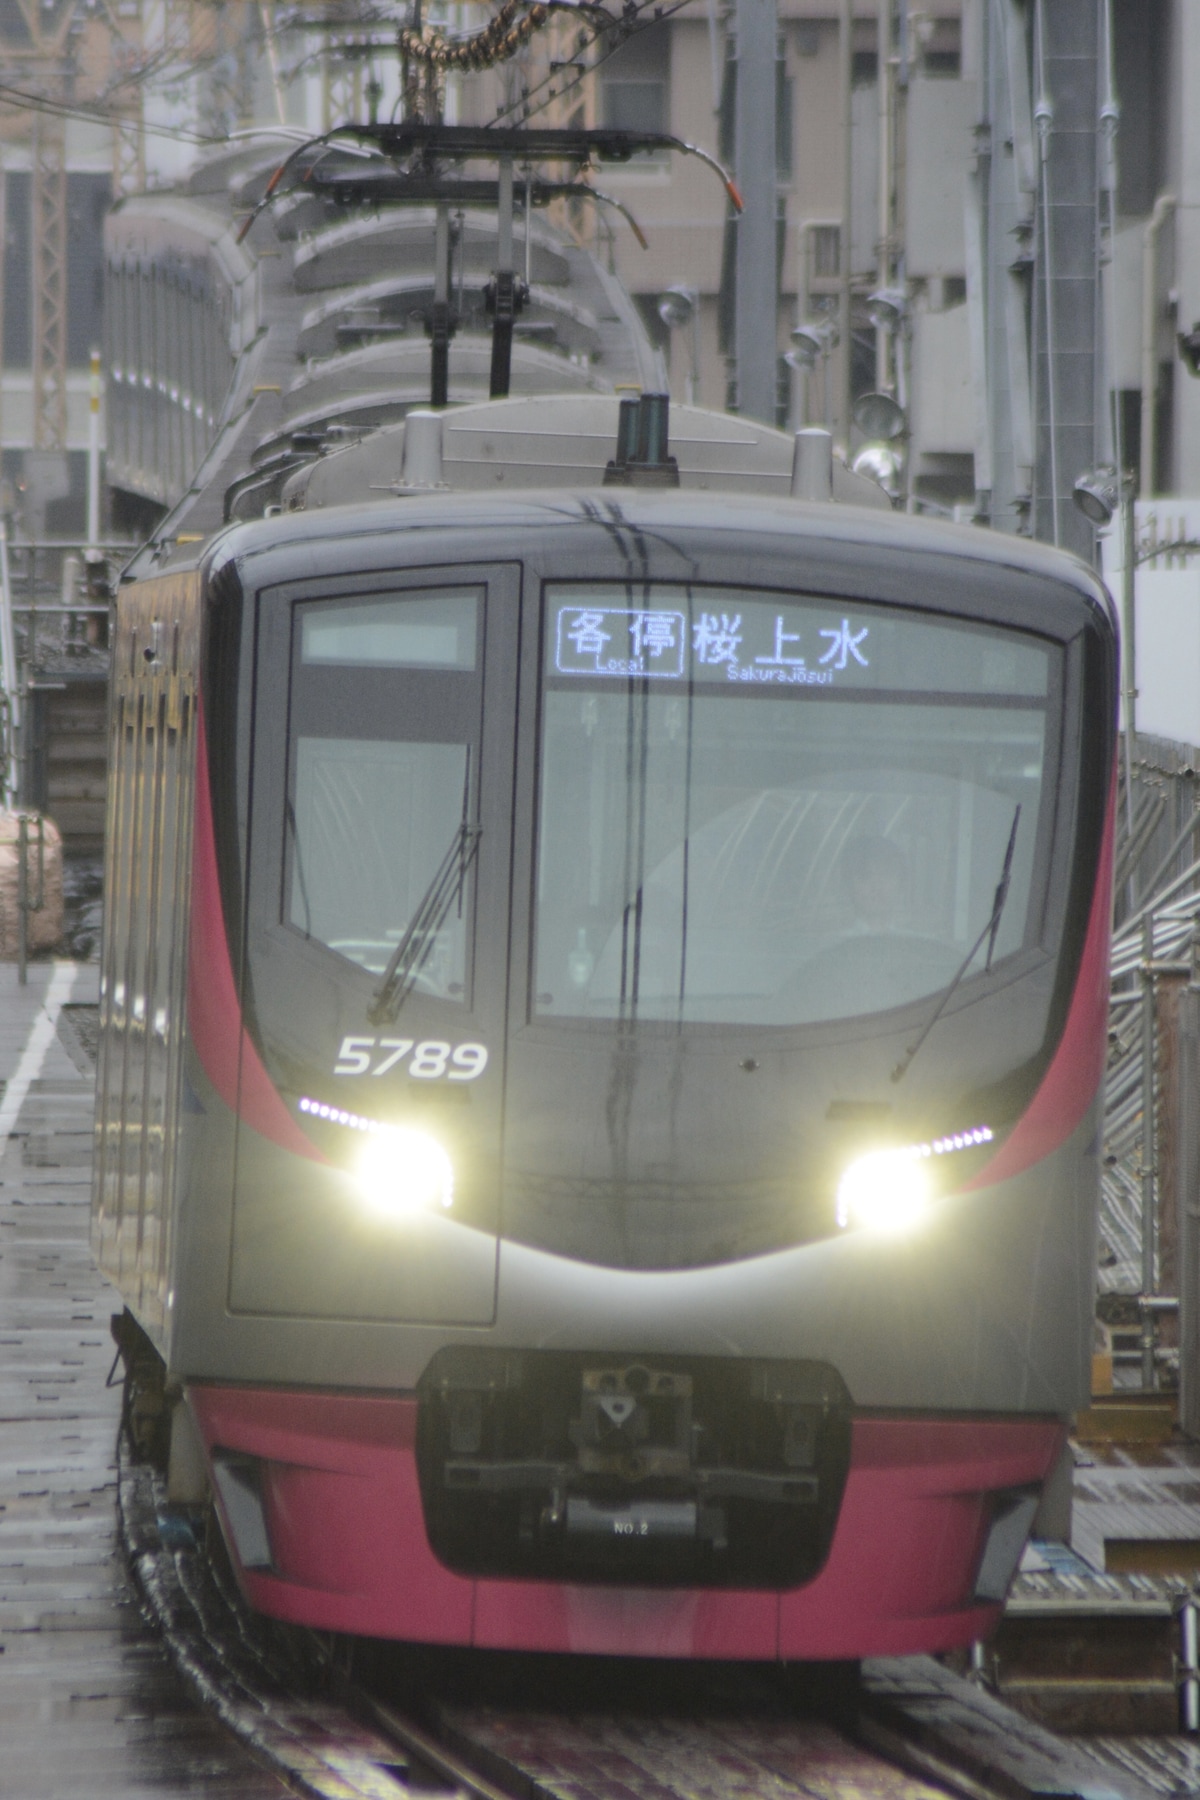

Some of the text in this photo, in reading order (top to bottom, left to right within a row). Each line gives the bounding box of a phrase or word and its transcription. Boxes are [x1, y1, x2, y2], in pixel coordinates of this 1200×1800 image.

[568, 611, 676, 657] 各停
[693, 613, 869, 669] 桜上水
[596, 655, 644, 671] Local
[333, 1037, 488, 1080] 5789
